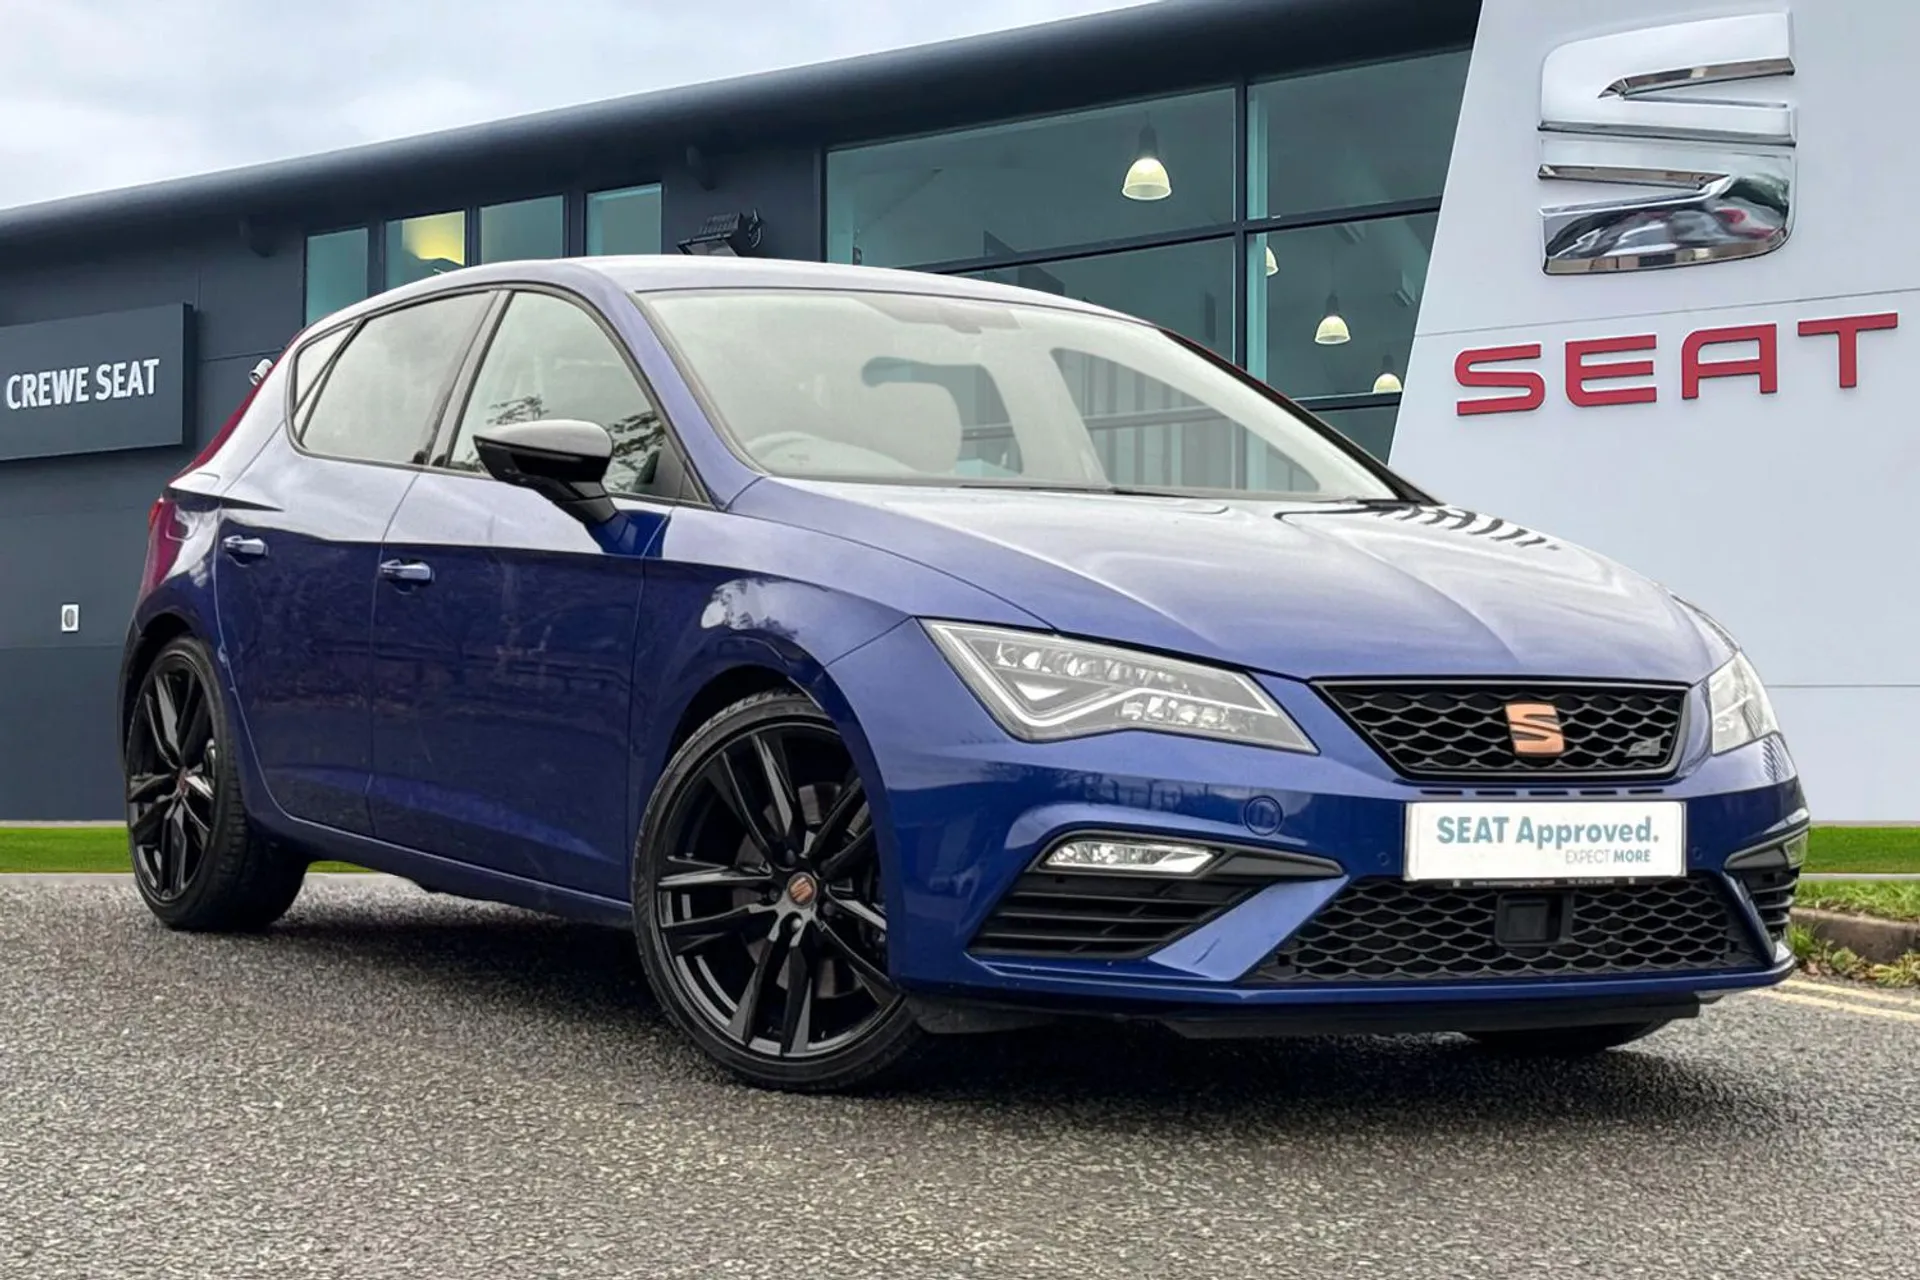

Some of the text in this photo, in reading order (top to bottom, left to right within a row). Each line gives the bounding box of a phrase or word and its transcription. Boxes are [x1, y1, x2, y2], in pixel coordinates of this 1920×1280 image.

[6, 358, 160, 410] CREWE SEAT
[1454, 312, 1898, 416] SEAT
[1436, 815, 1659, 850] SEAT Approved.
[1565, 849, 1652, 864] EXPECT MORE
